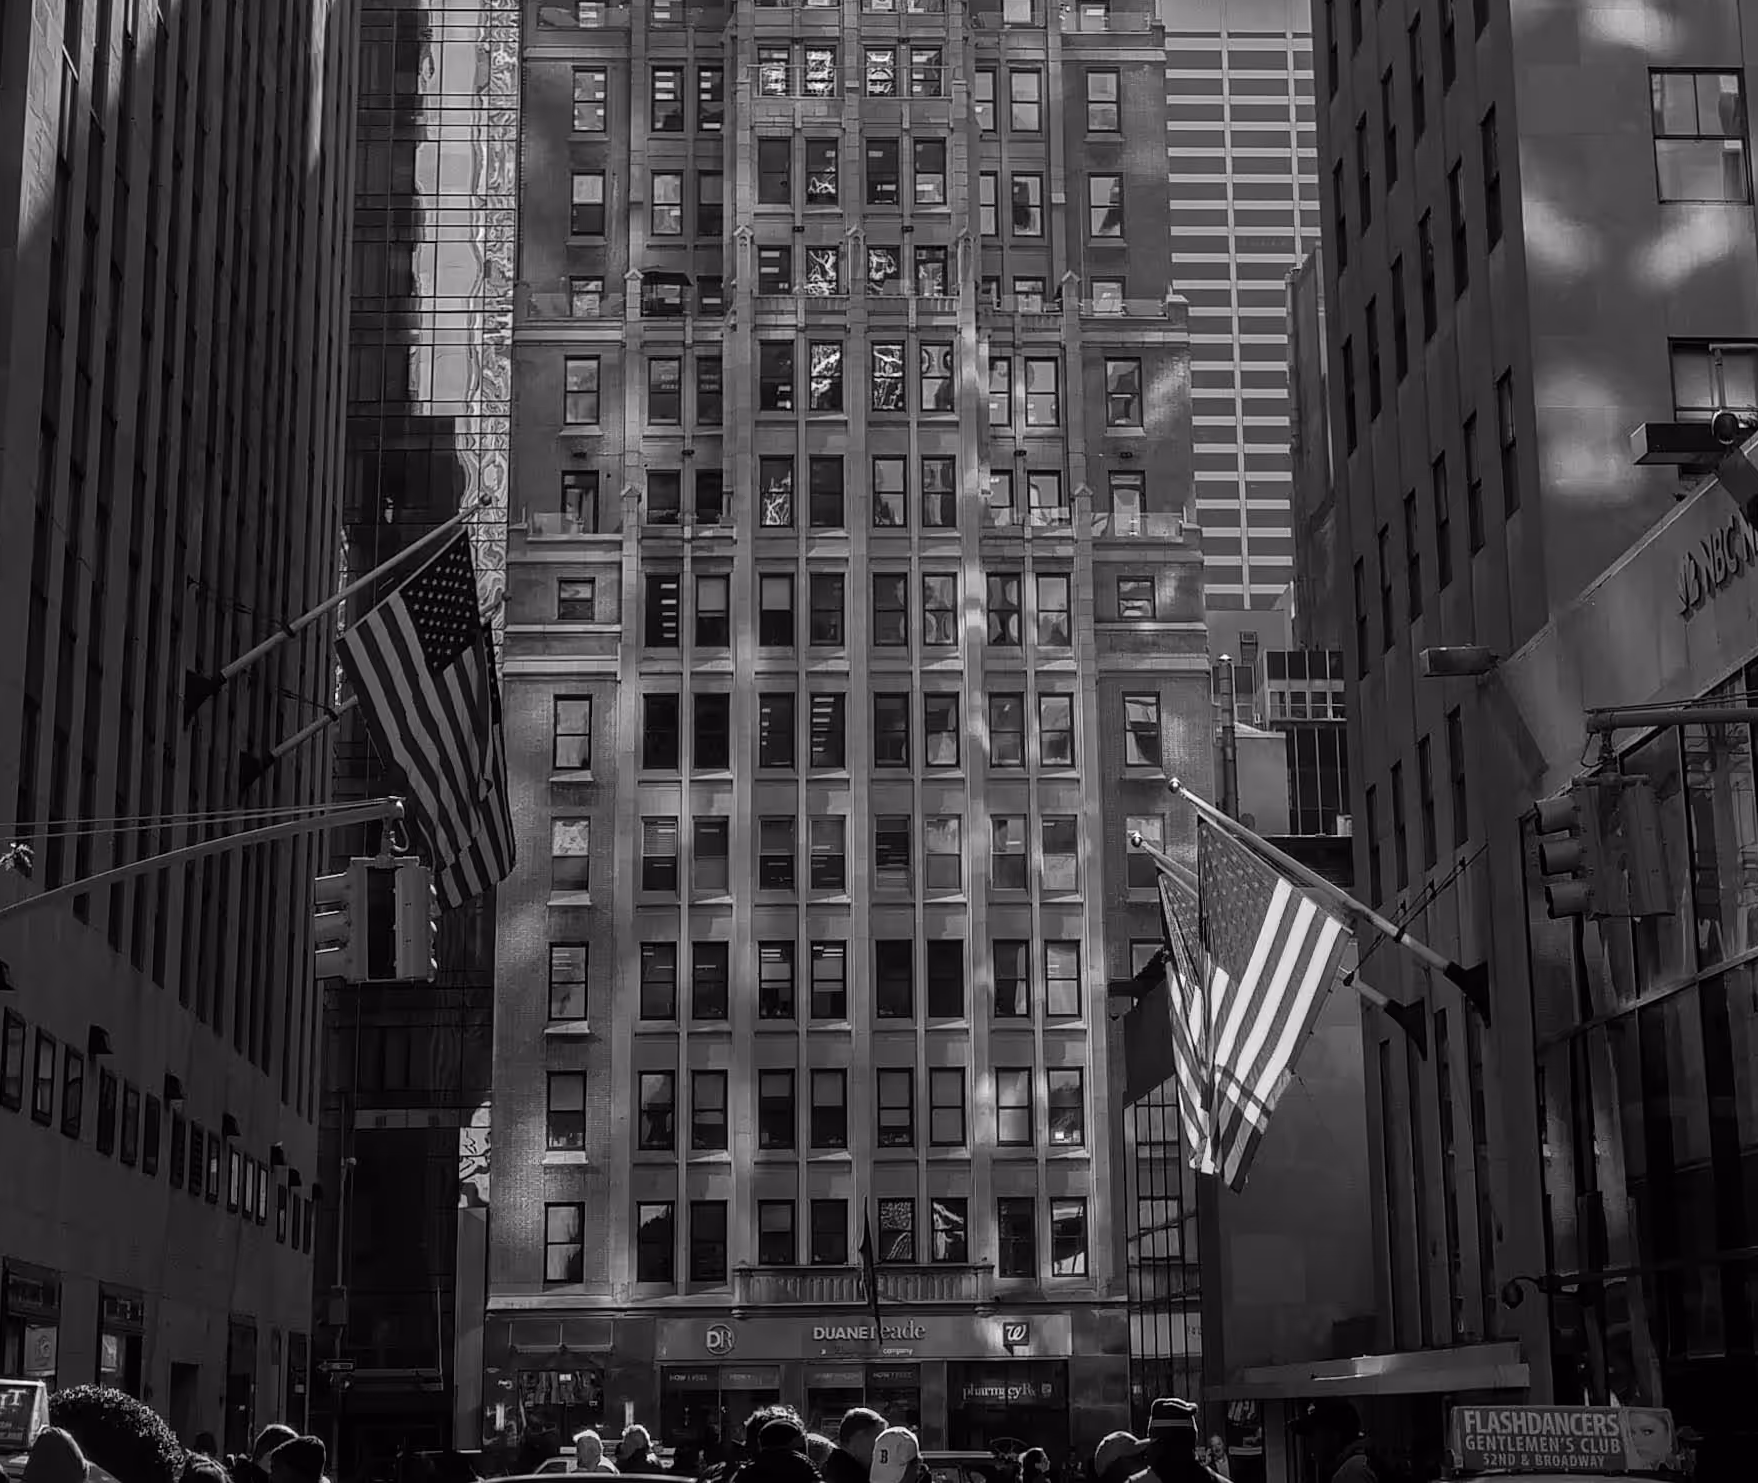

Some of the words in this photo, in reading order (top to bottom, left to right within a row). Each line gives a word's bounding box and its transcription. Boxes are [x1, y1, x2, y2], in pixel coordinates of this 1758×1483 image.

[1463, 1409, 1620, 1437] FLASHDANCERS
[1465, 1435, 1575, 1453] GENTLEMEN'S
[1580, 1437, 1621, 1454] CLUB
[1482, 1452, 1516, 1467] 52ND
[1535, 1454, 1605, 1468] BROADWAY
